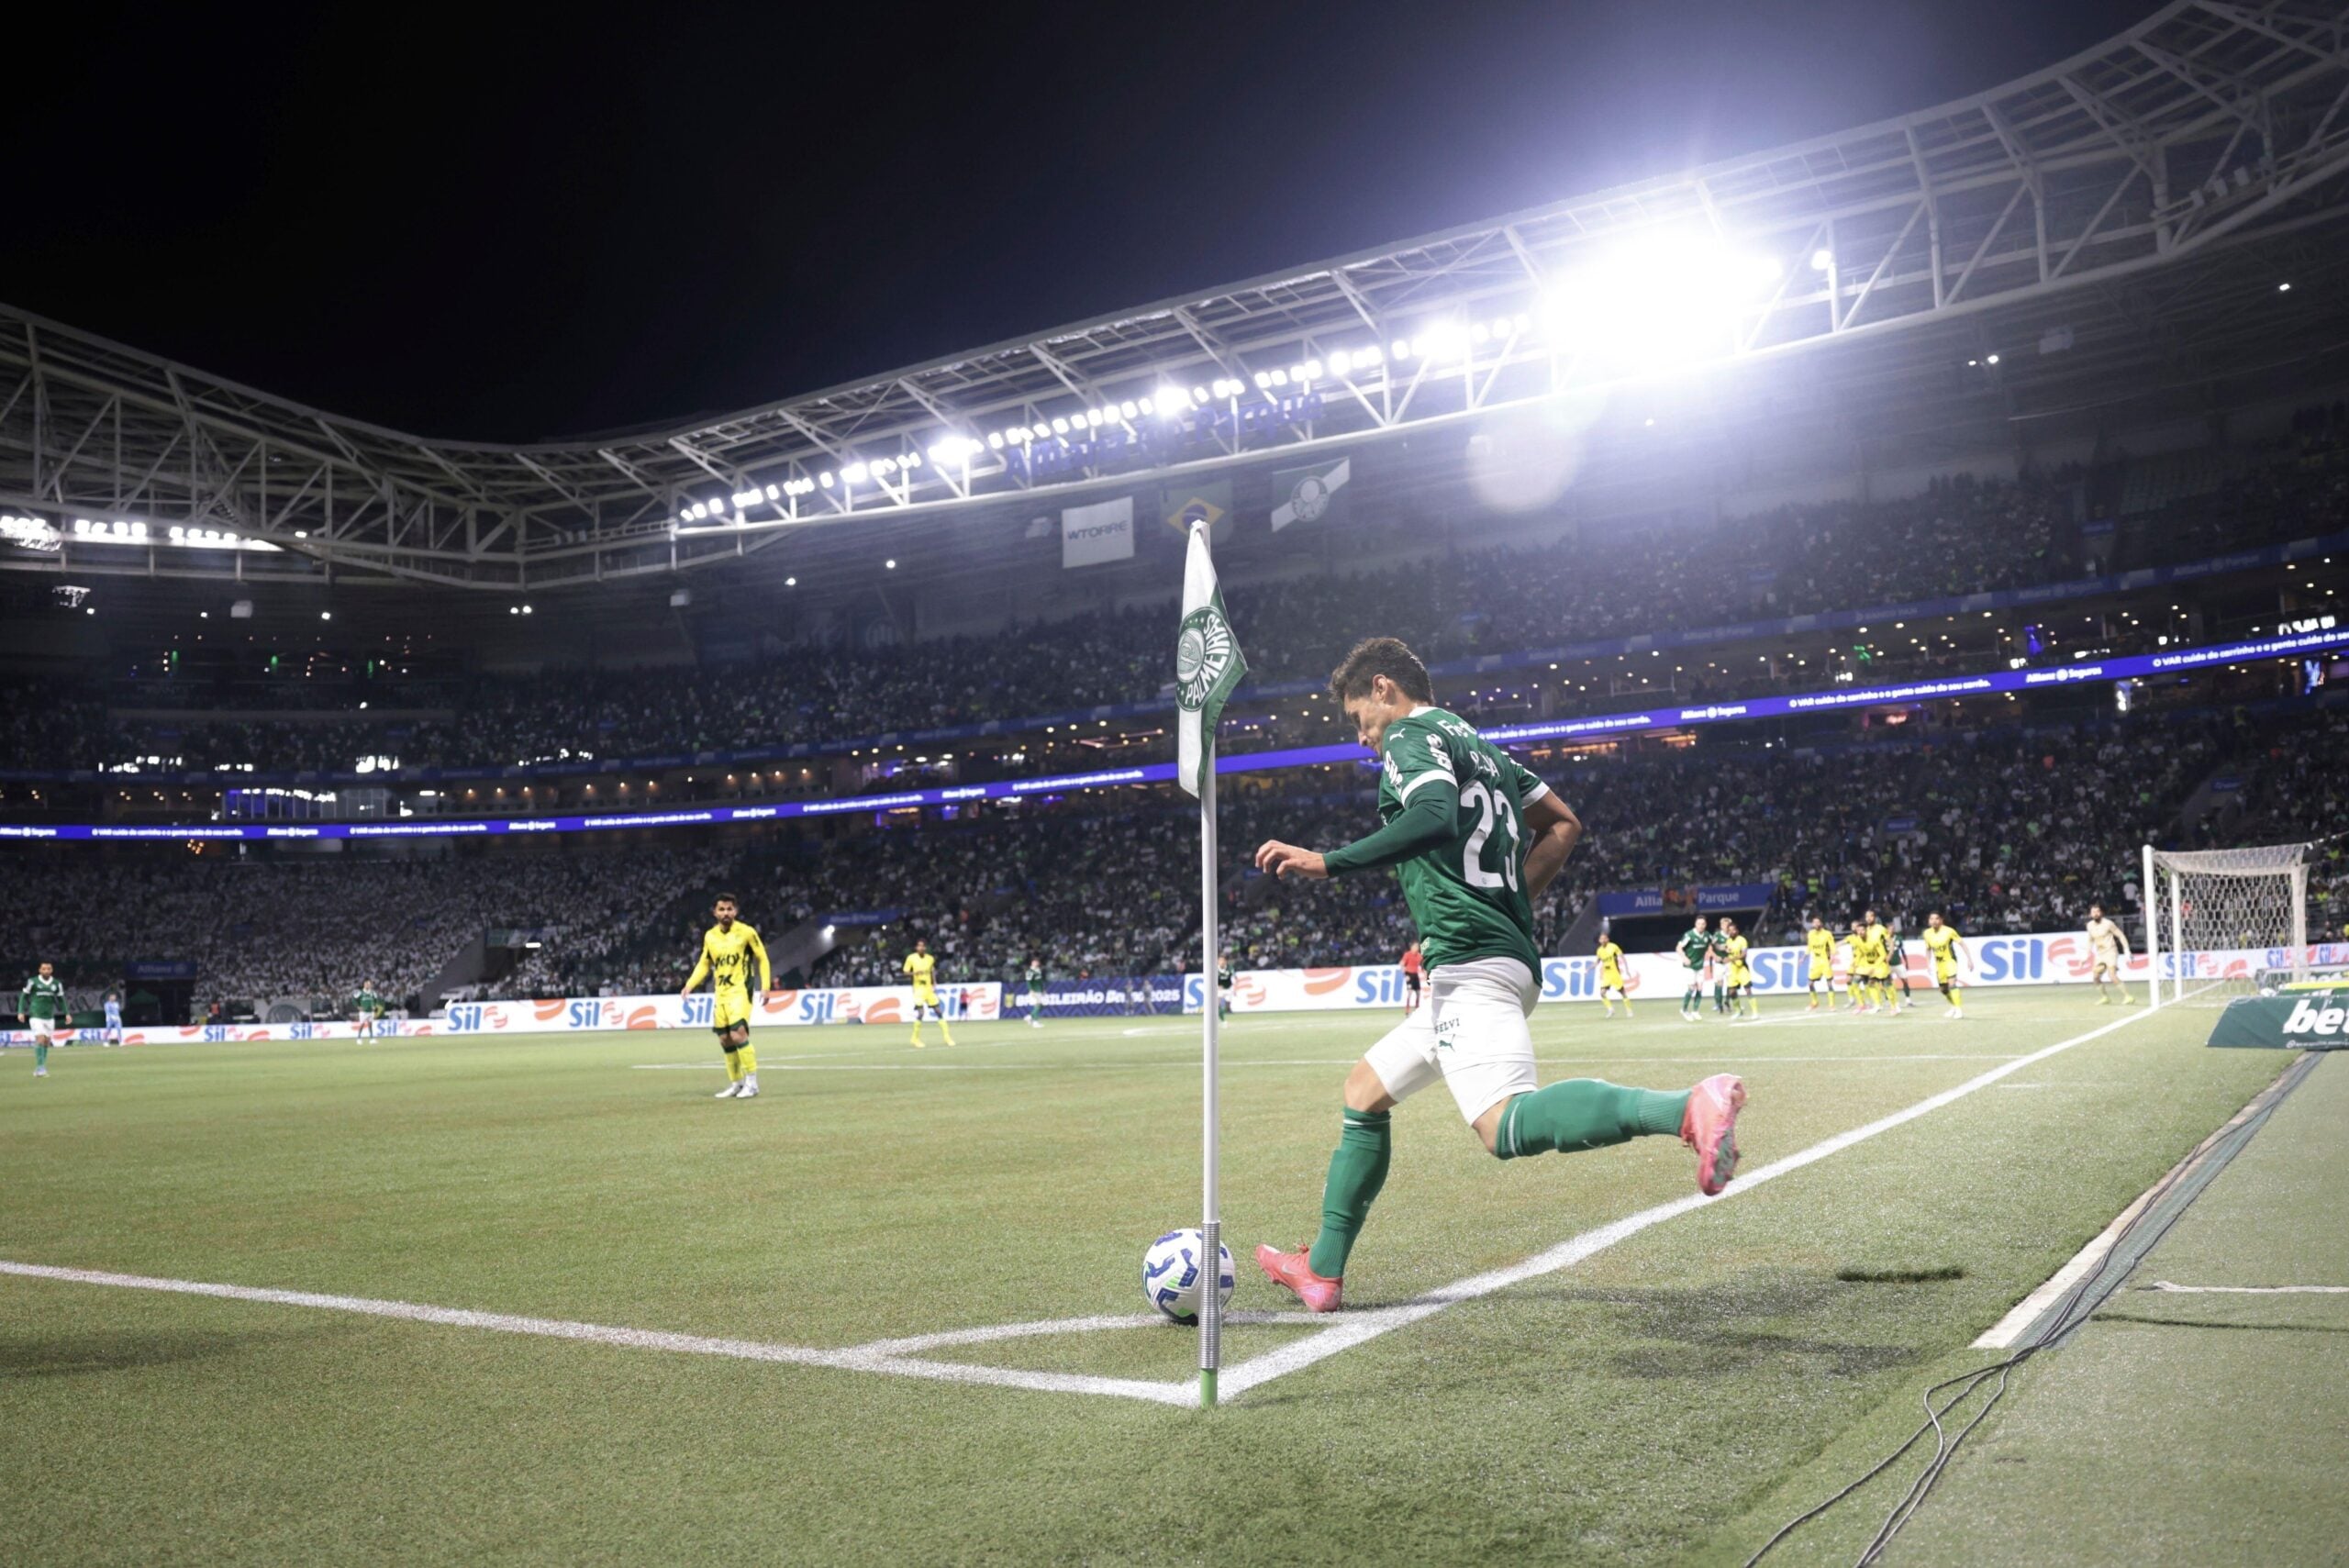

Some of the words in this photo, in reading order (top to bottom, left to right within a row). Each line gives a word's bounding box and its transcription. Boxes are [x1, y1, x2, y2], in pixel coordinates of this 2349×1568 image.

[1067, 520, 1129, 540] WTORRE
[1184, 613, 1231, 706] PALMEIRAS
[2026, 673, 2055, 683] Allianz
[2068, 666, 2103, 679] Seguros
[1635, 895, 1663, 908] Allia
[1698, 891, 1739, 905] Parque
[1752, 951, 1809, 990] Sil
[1980, 939, 2043, 981] Sil
[1356, 969, 1404, 1003] Sil
[1542, 961, 1595, 997] Sil
[569, 1001, 600, 1028] Sil
[681, 997, 714, 1024] Sil
[799, 993, 835, 1021] Sil
[930, 988, 967, 1017] Si
[290, 1022, 312, 1039] Sil
[377, 1020, 397, 1036] Sil
[448, 1006, 482, 1031] Sil
[204, 1025, 226, 1042] Sil
